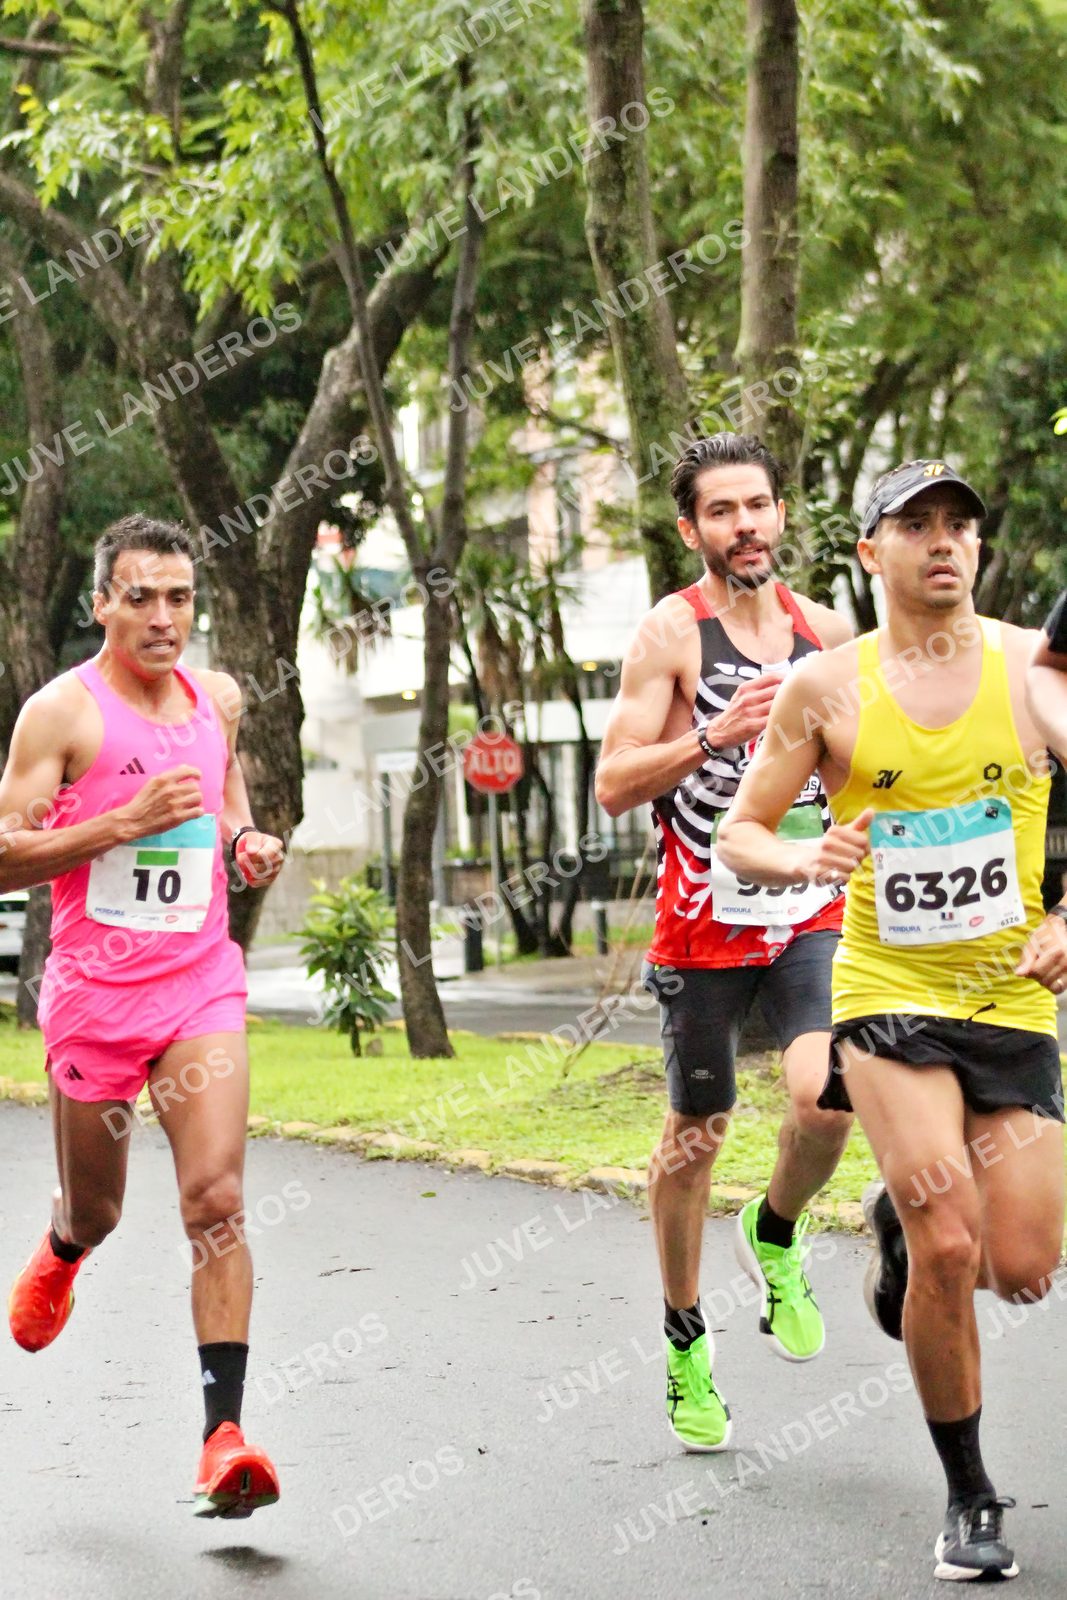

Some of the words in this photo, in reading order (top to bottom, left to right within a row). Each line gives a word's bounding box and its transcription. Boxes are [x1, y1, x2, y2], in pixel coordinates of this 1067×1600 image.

[469, 750, 517, 776] ALTO
[873, 769, 903, 789] 3V
[133, 868, 181, 904] 10
[885, 858, 1007, 912] 6326
